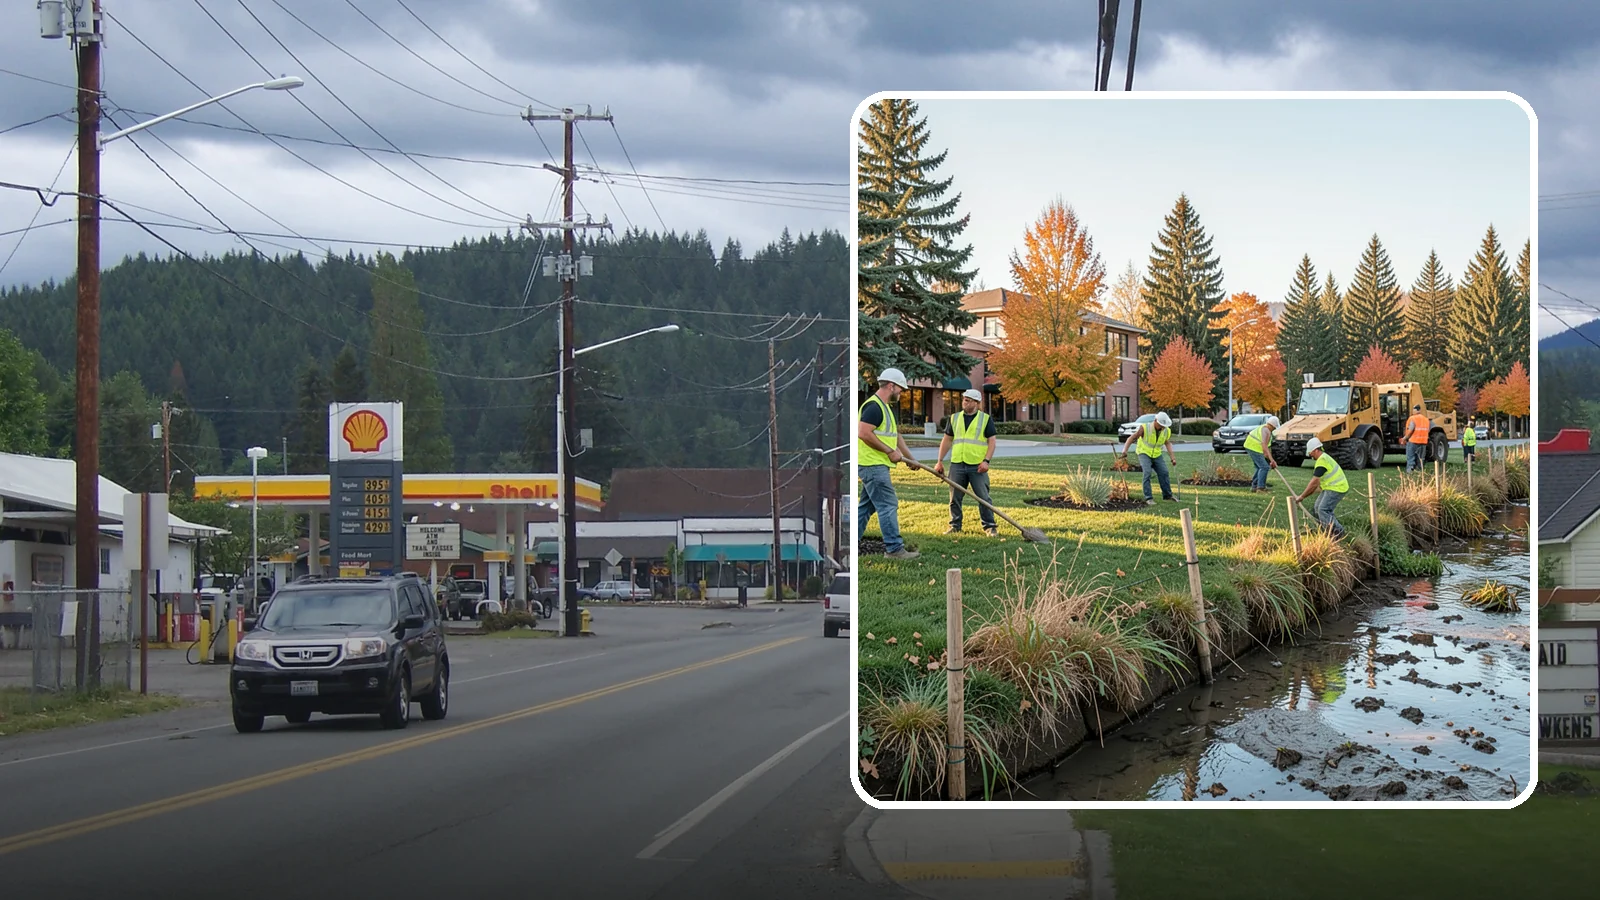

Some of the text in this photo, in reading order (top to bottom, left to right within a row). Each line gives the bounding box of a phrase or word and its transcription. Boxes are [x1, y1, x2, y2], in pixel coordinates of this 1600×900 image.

[366, 480, 383, 490] 395
[490, 484, 547, 499] Shell
[366, 494, 383, 504] 405
[366, 508, 383, 518] 415
[366, 522, 383, 532] 429
[1538, 643, 1567, 665] AID
